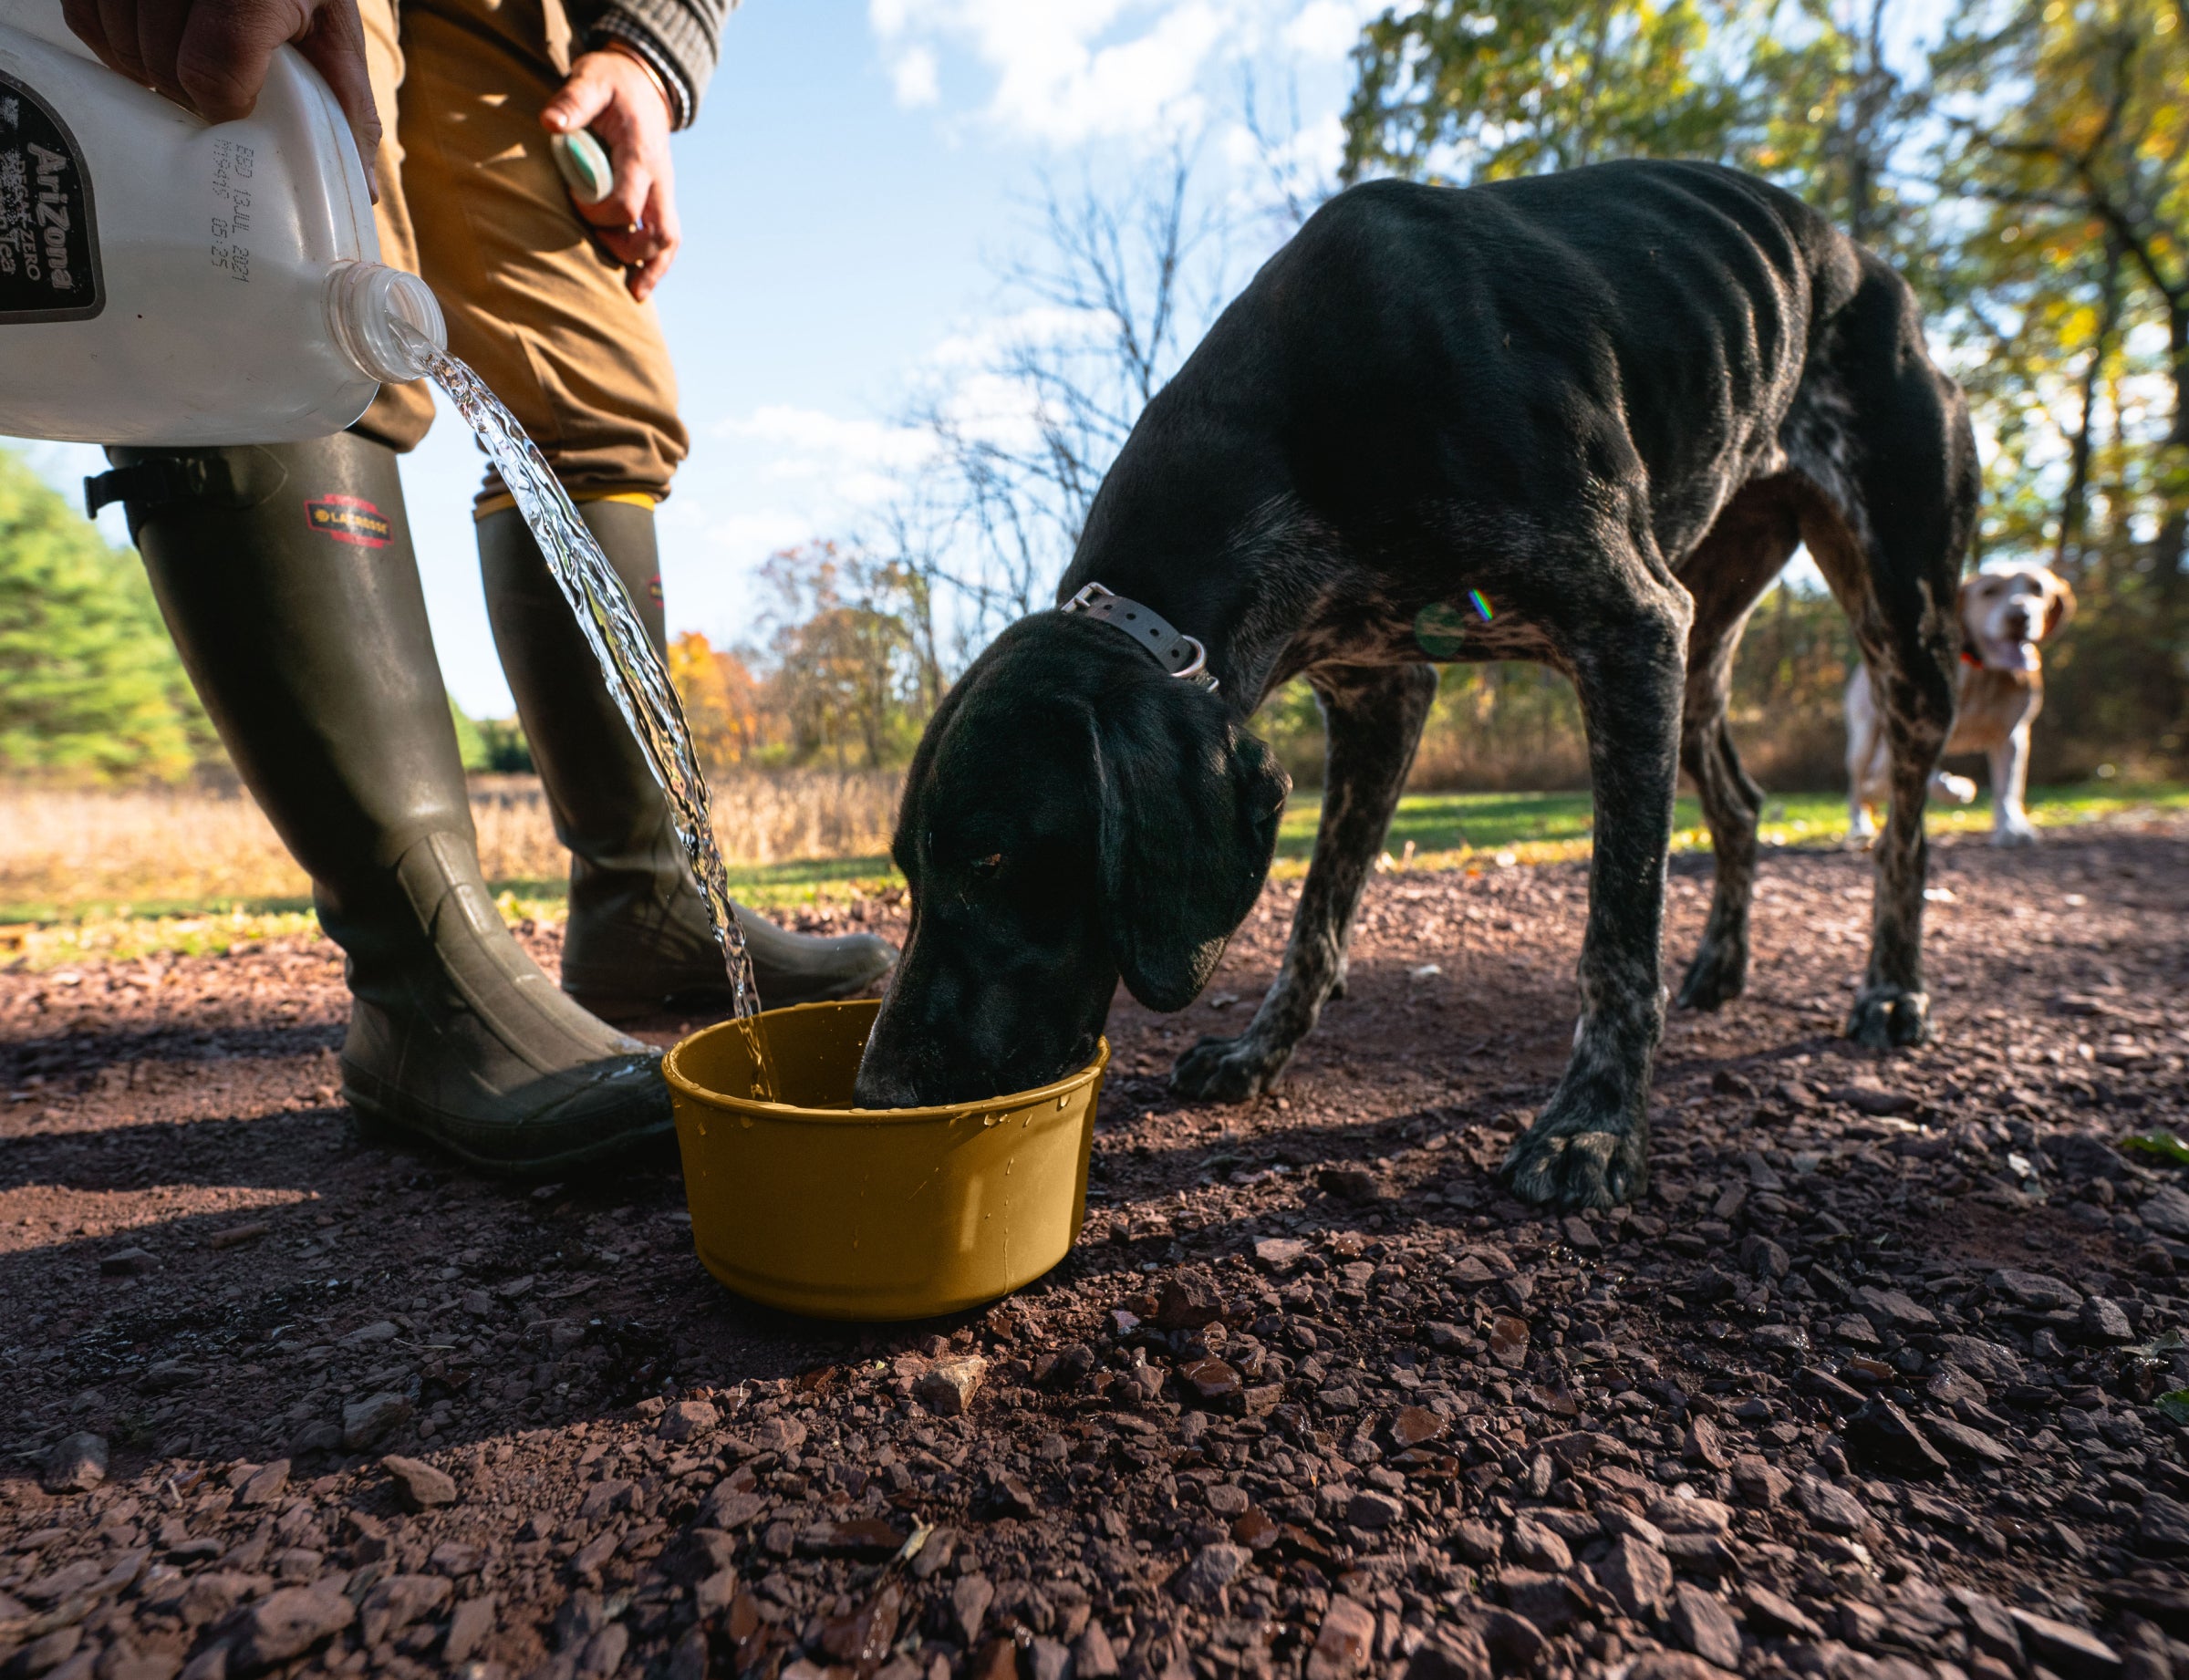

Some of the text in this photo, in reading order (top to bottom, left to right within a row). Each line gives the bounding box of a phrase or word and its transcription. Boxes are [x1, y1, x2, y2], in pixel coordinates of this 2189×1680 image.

[27, 141, 72, 289] AriZona
[232, 189, 252, 233] 13JUL
[212, 217, 229, 269] 05:25
[232, 244, 250, 283] 2021
